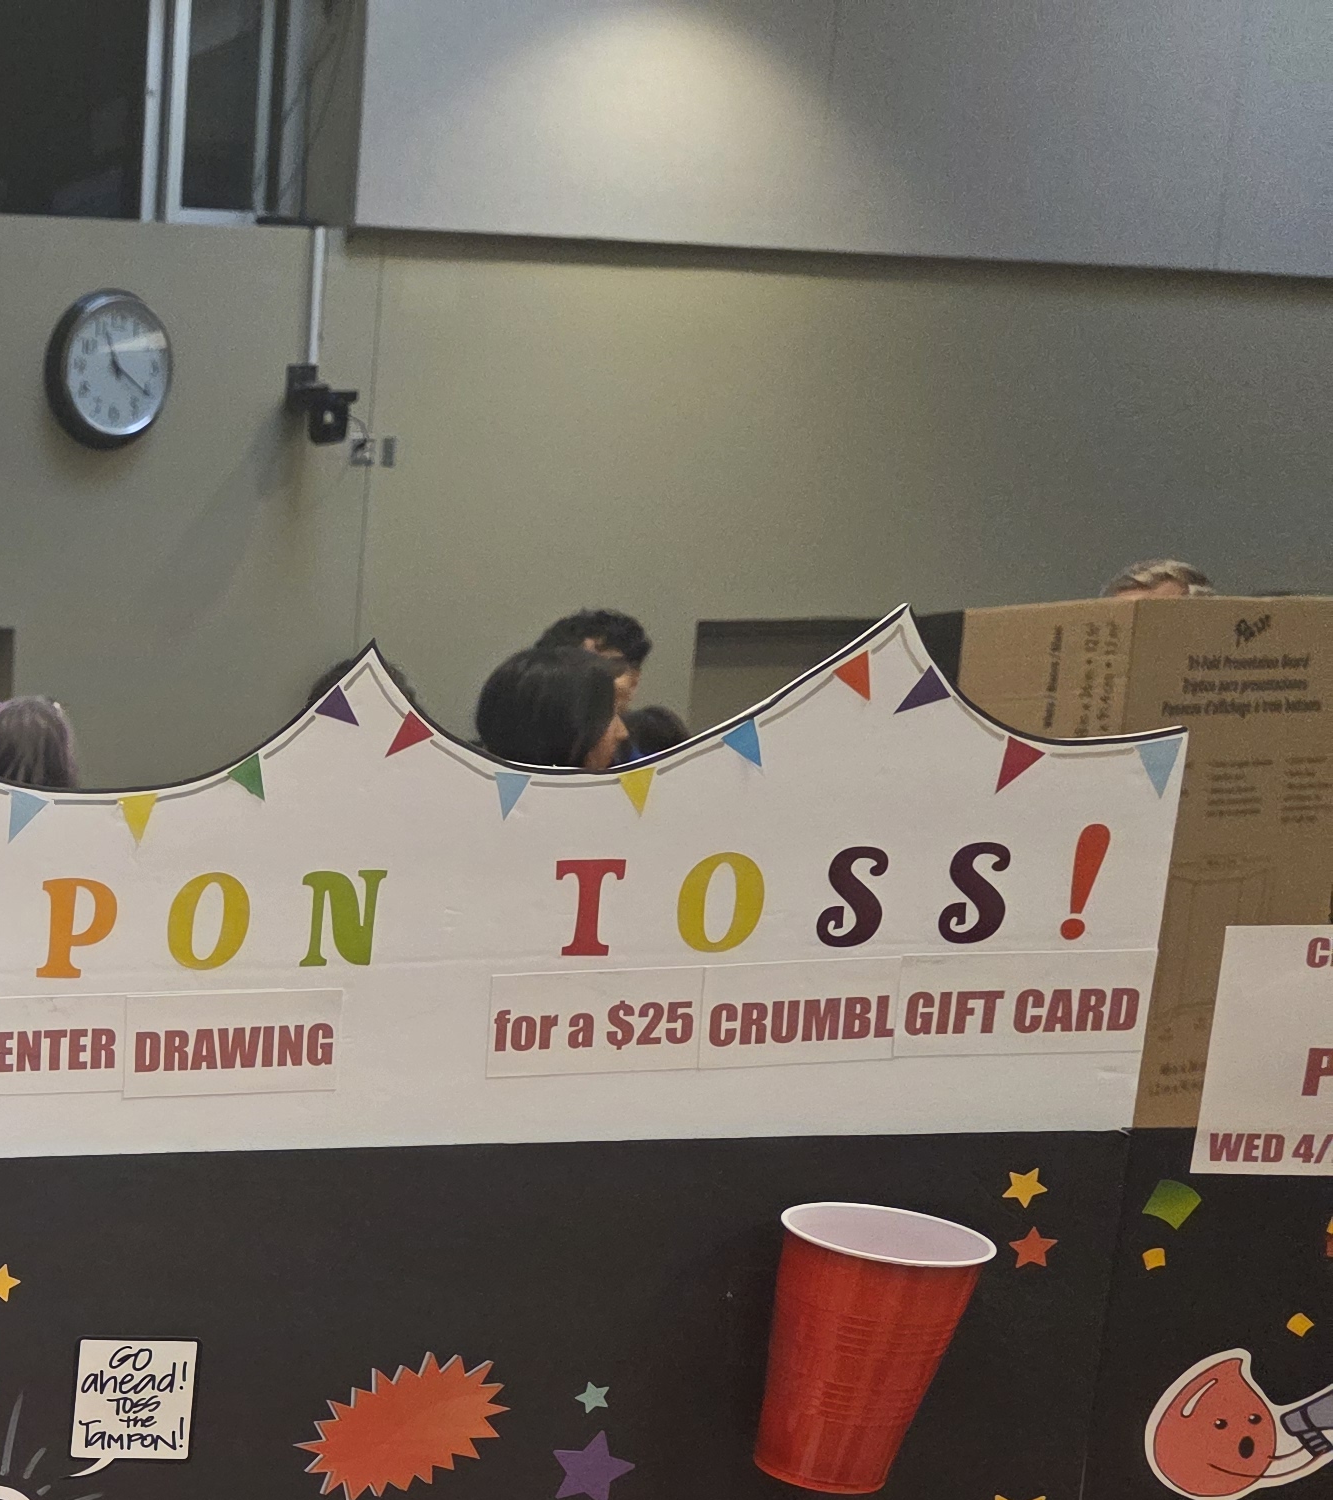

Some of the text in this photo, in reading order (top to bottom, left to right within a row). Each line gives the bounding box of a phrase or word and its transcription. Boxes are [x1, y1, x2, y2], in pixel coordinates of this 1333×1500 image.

[555, 823, 1111, 957] TOSS!
[494, 987, 1140, 1053] for a $25 CRUMBL GIFT CARD
[133, 1023, 334, 1073] DRAWING
[1210, 1133, 1285, 1162] WED
[81, 1361, 187, 1394] ahead!
[119, 1416, 157, 1428] the
